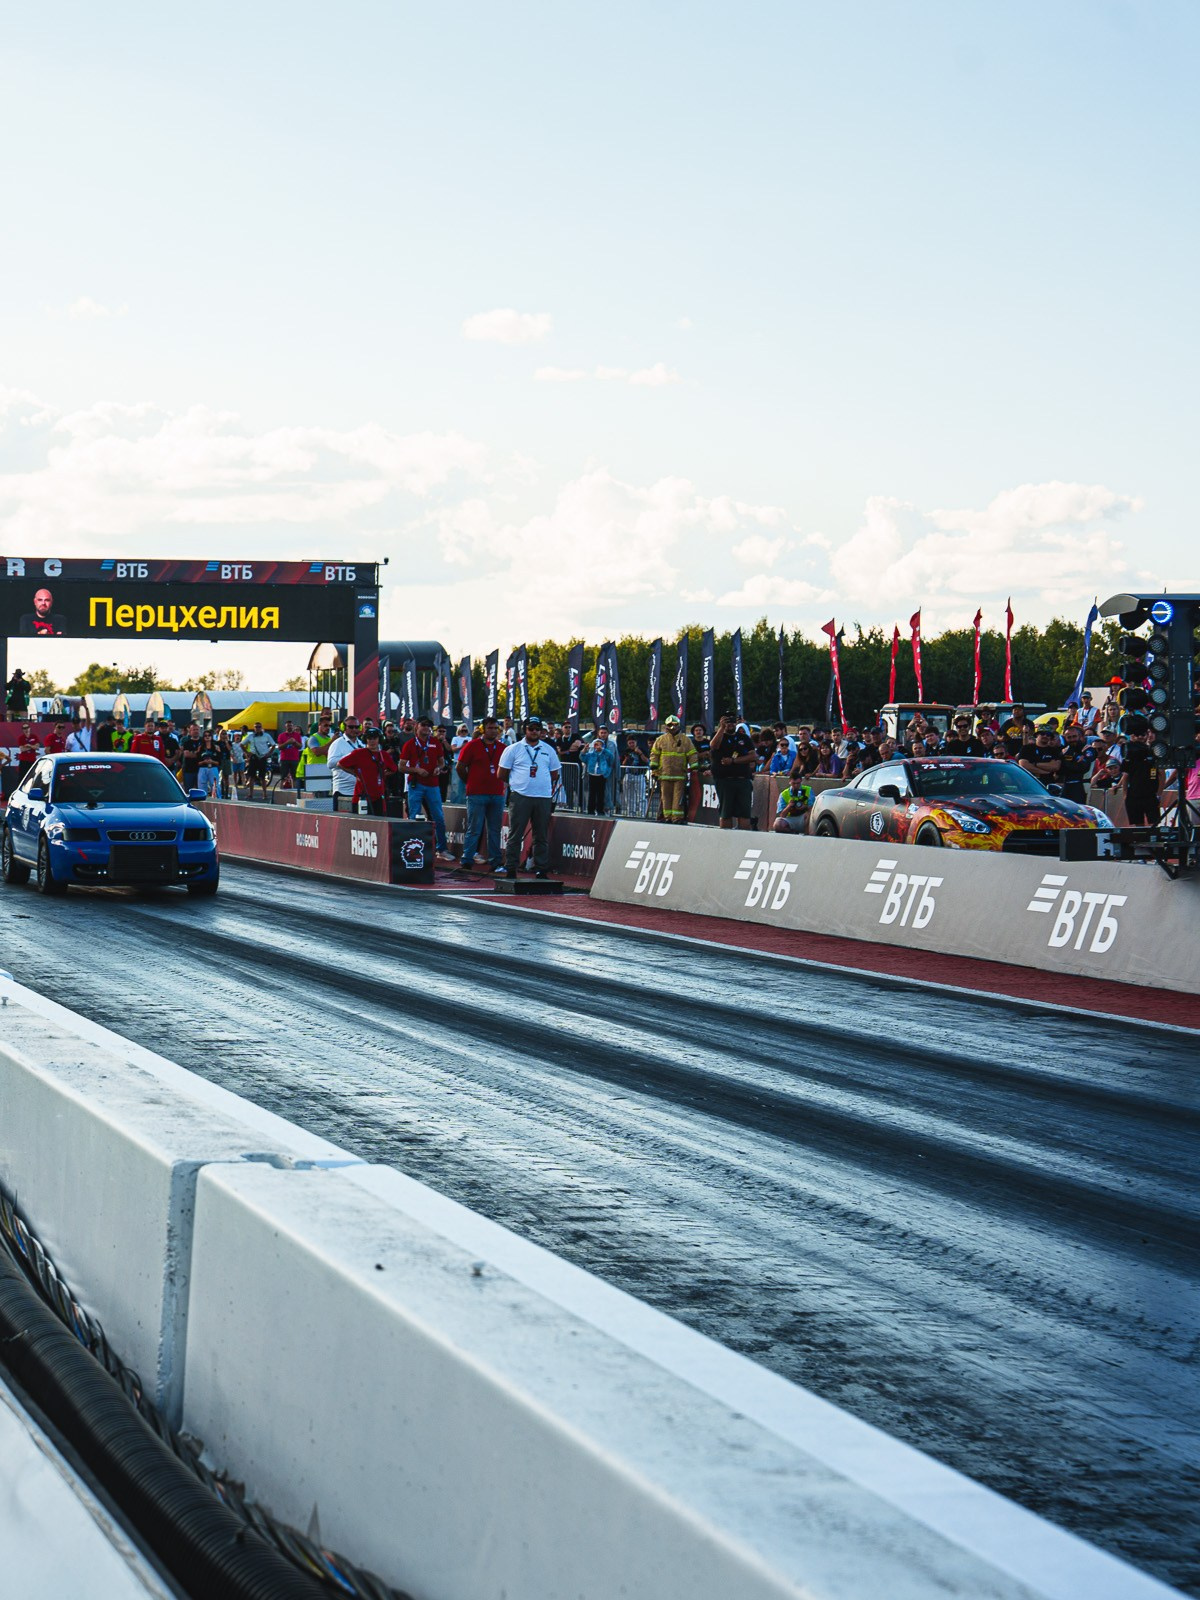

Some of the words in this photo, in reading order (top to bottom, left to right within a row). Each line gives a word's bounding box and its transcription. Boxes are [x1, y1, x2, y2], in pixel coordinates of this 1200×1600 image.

[116, 563, 149, 578] ВТБ
[221, 564, 253, 580] ВТБ
[325, 566, 356, 581] ВТБ
[89, 597, 280, 632] Перцхелия
[350, 829, 378, 858] RDRC
[562, 843, 595, 860] ROSGONKI
[634, 851, 680, 897] ВТБ
[745, 861, 798, 910] ВТБ
[879, 873, 944, 929] ВТБ
[1048, 890, 1128, 953] ВТБ
